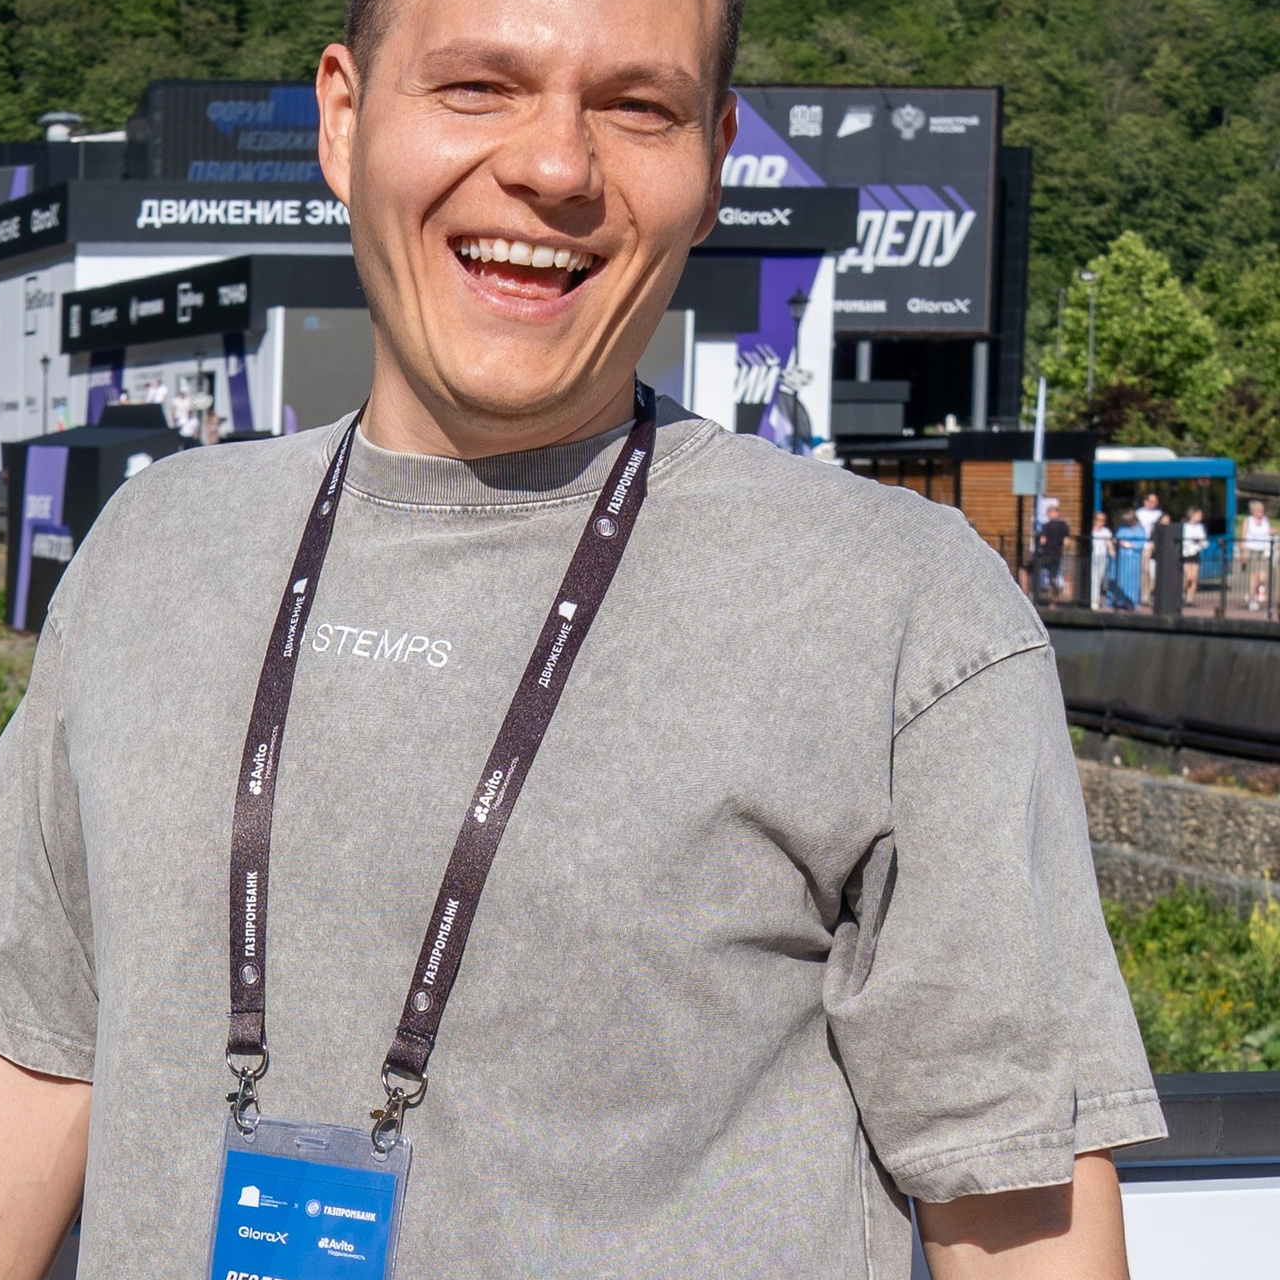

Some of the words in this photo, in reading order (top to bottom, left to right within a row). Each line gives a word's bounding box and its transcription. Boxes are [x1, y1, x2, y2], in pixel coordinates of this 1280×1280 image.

[136, 199, 302, 229] ДВИЖЕНИЕ
[718, 207, 793, 226] GloraX
[837, 210, 977, 273] ДЕЛУ
[907, 297, 971, 313] GloraX
[607, 448, 645, 515] ГАЗПРОМБАНК
[284, 595, 306, 658] ДВИЖЕНИЕ
[312, 623, 453, 669] STEMPS
[538, 622, 573, 689] ДВИЖЕНИЕ
[250, 743, 268, 780] Avito
[479, 769, 503, 808] Avito
[245, 870, 258, 957] ГАЗПРОМБАНК
[423, 898, 460, 986] ГАЗПРОМБАНК
[324, 1205, 376, 1222] ГАЗПРОМБАНК
[238, 1226, 289, 1245] GloraX
[329, 1239, 355, 1253] Avito
